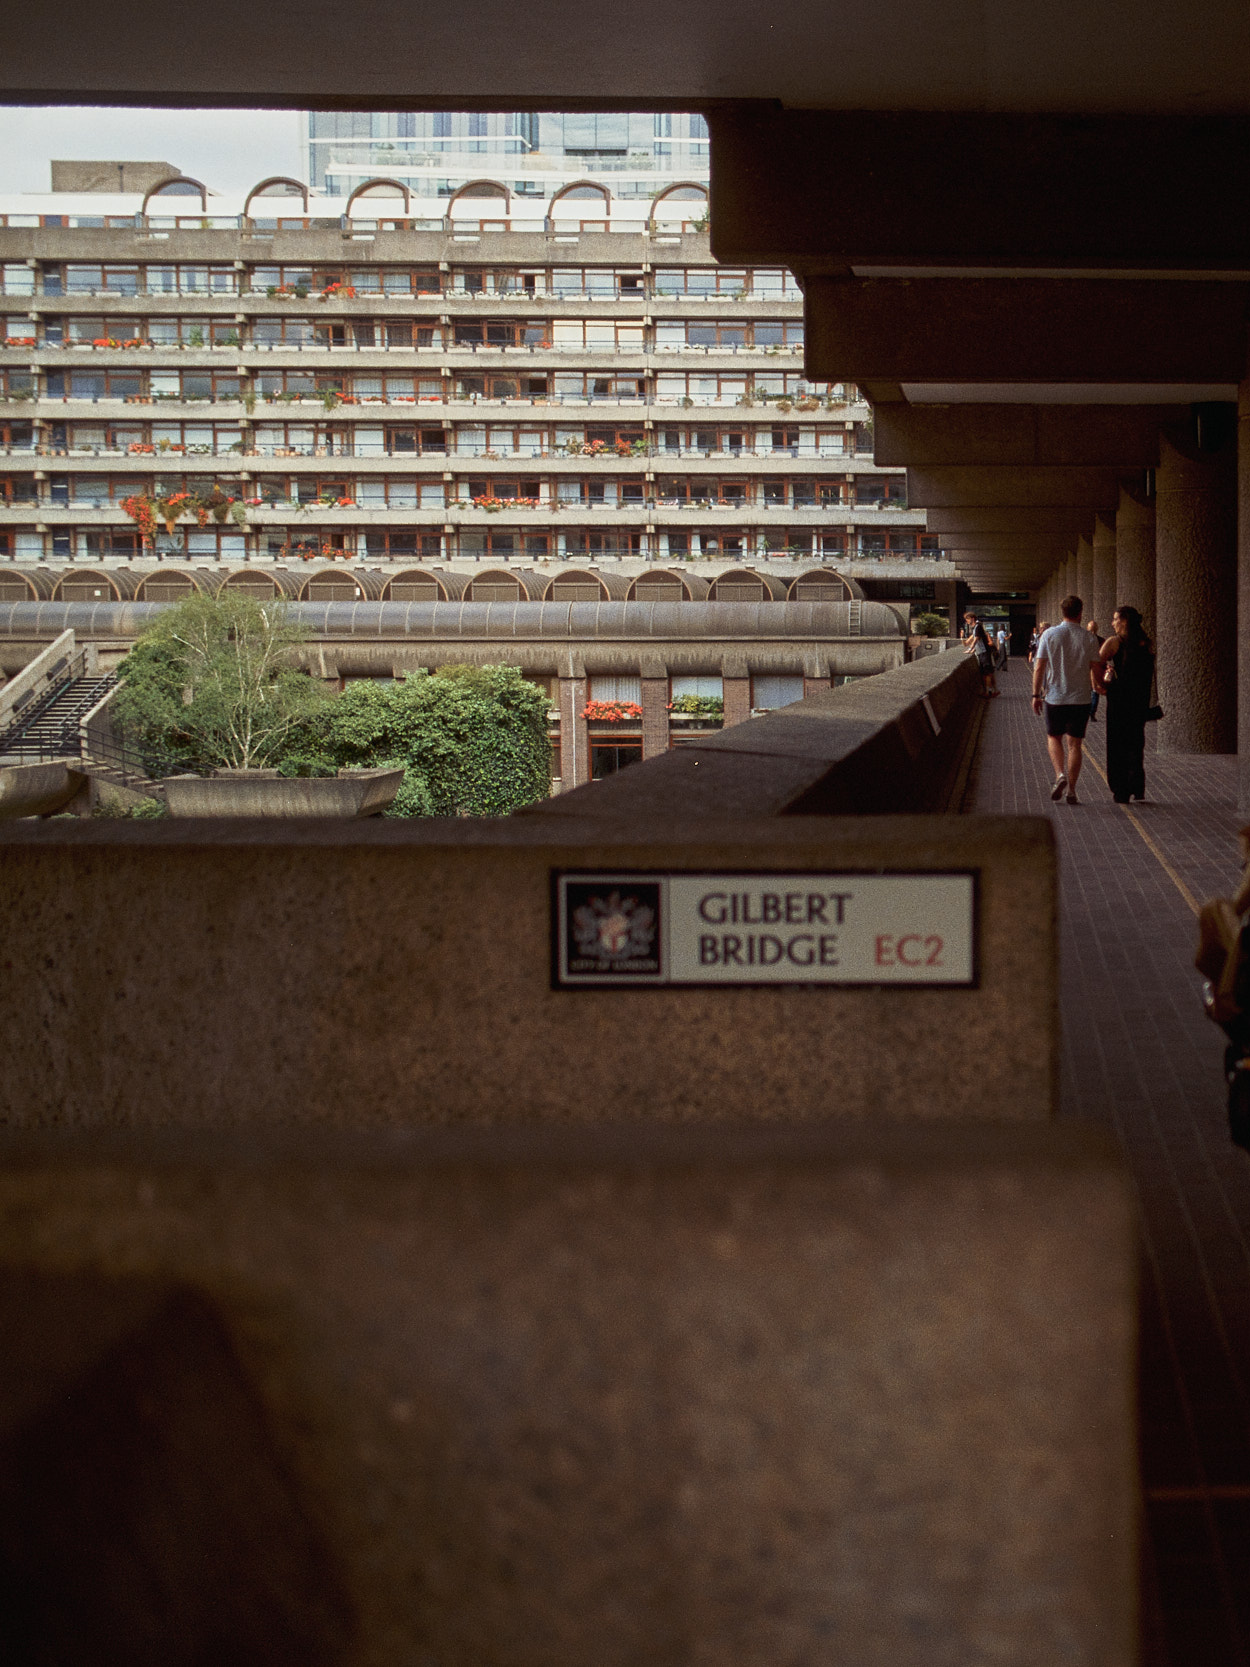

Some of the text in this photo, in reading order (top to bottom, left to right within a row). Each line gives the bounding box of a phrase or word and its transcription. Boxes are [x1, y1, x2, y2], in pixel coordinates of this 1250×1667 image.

[699, 892, 853, 926] GILBERT
[700, 934, 945, 967] BRIDGE EC2
